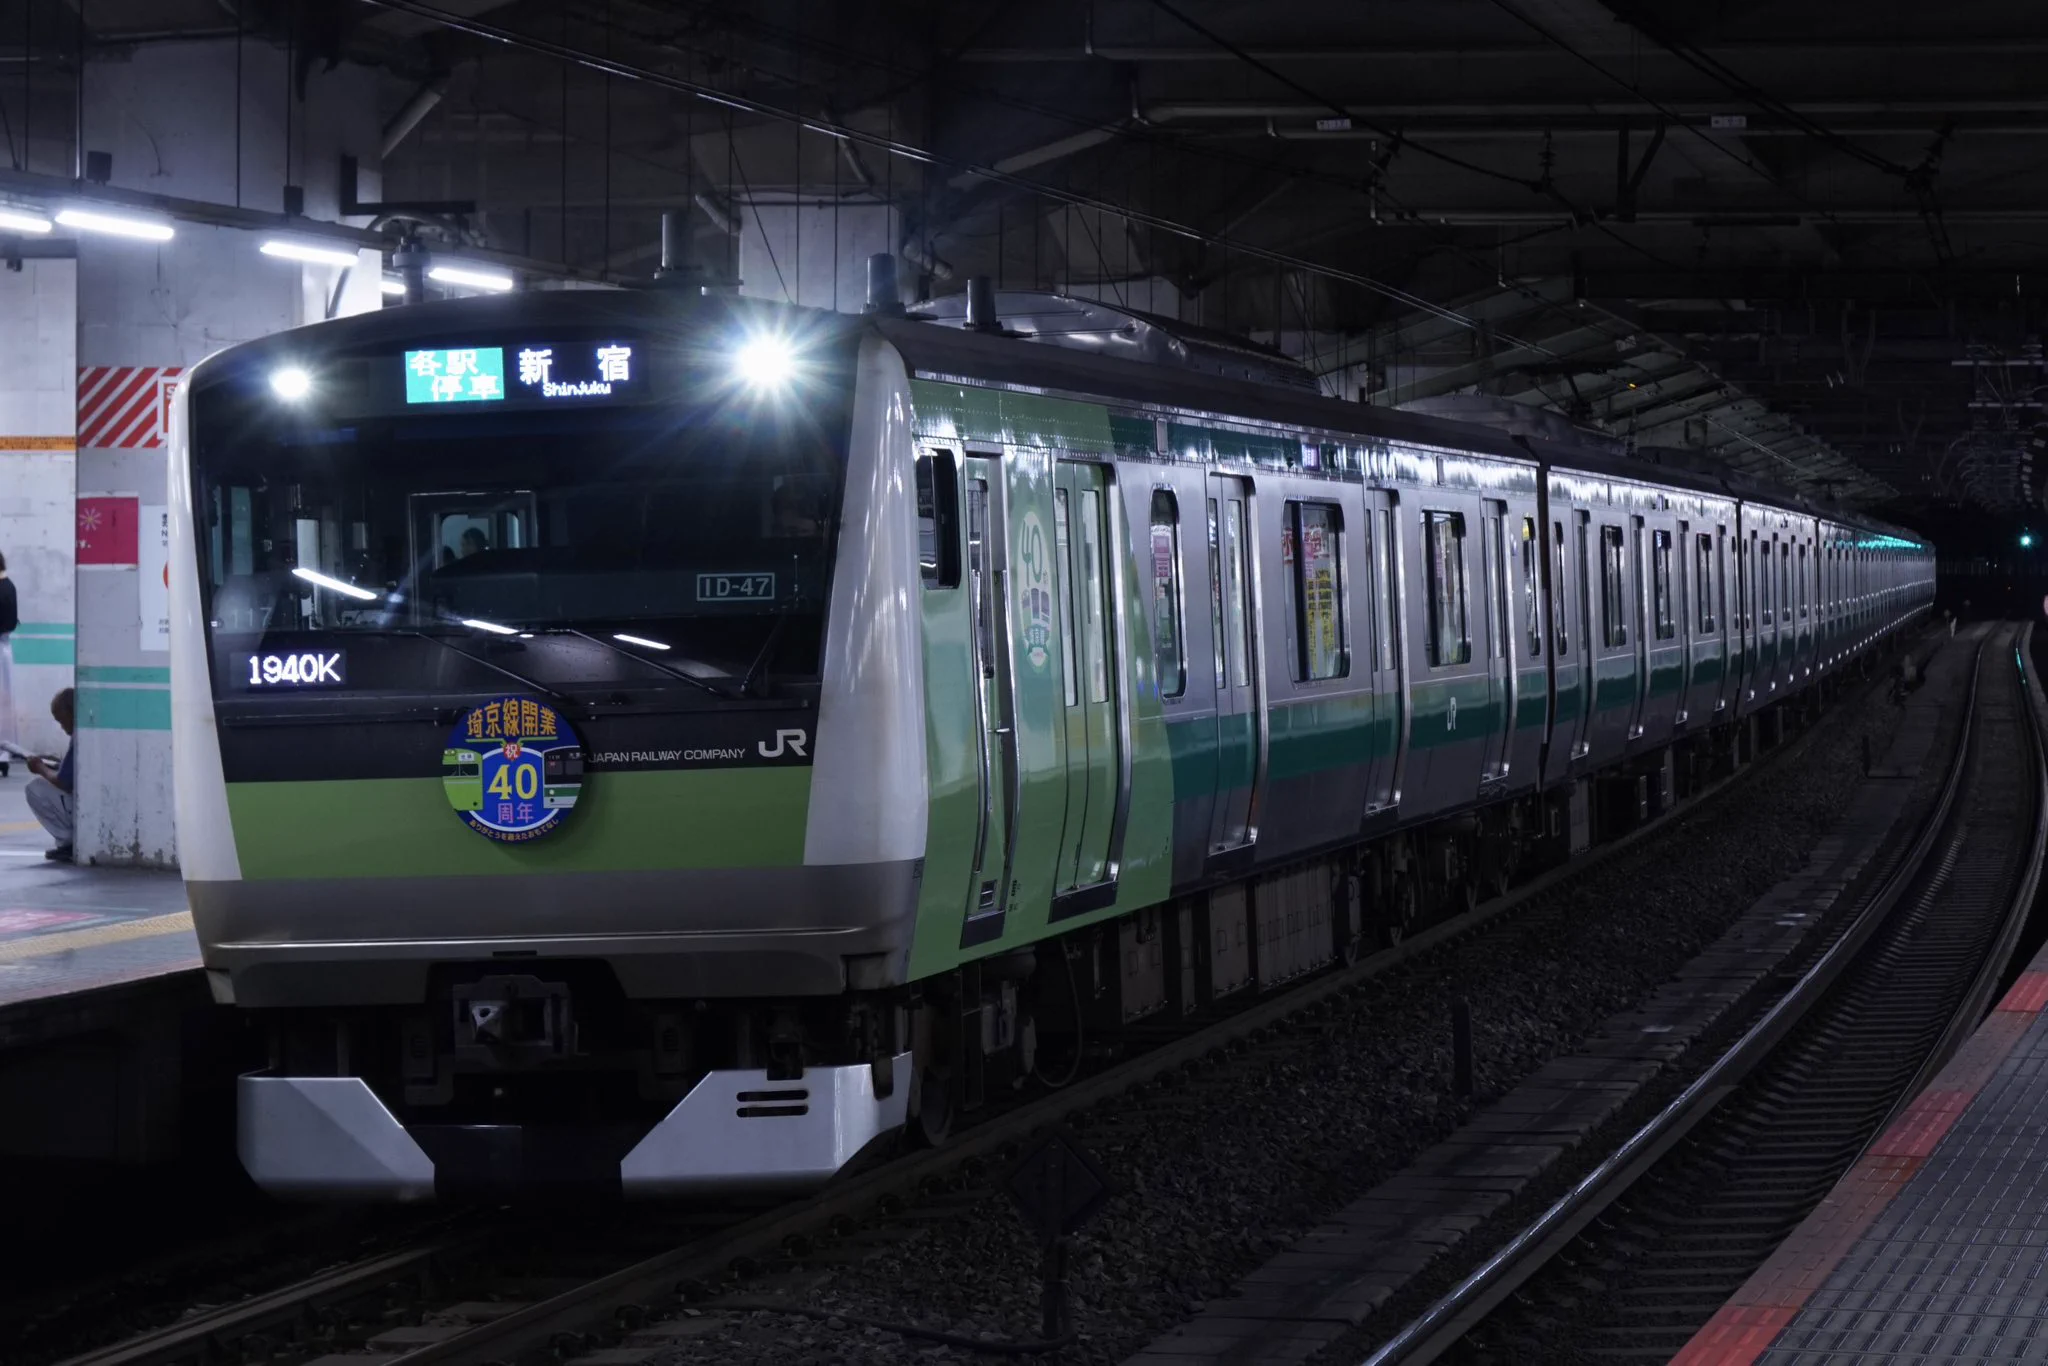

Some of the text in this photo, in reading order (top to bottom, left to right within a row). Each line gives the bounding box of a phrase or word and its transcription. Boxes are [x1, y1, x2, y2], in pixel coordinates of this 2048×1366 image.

[410, 350, 478, 376] 各駅
[431, 373, 500, 400] 停車
[543, 380, 611, 397] Shinjuku
[704, 577, 769, 597] ID-47
[248, 652, 342, 685] 1940K
[467, 699, 557, 738] 埼京線開業
[504, 743, 519, 758] 祝
[588, 752, 629, 763] JAPAN
[631, 750, 682, 762] RAILWAY
[684, 748, 745, 760] COMPANY
[757, 728, 808, 758] JR
[487, 763, 538, 800] 40
[497, 802, 534, 824] 周年
